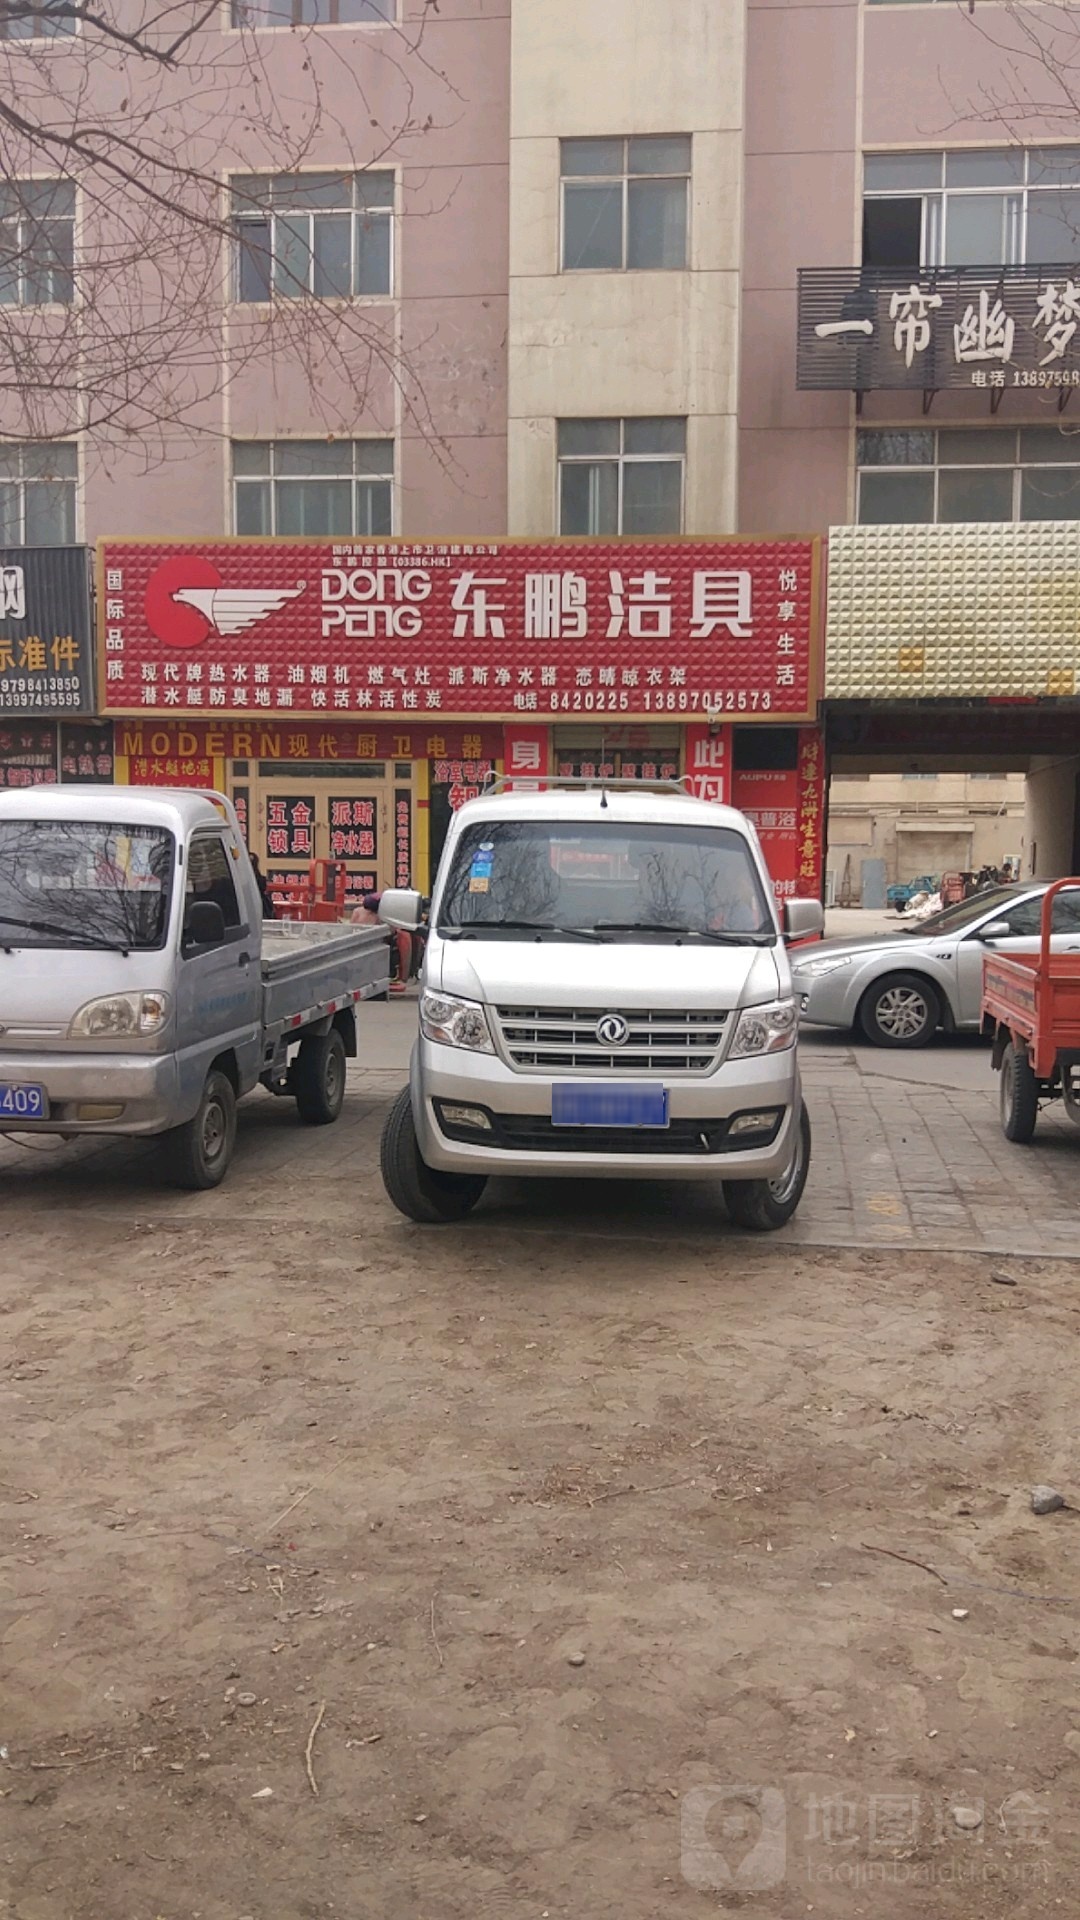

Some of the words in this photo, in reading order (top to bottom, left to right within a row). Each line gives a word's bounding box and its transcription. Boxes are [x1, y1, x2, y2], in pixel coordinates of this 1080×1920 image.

[971, 370, 1005, 387] 电话
[449, 570, 753, 638] 东鹏洁具
[106, 570, 126, 681] 国际品质
[776, 569, 798, 685] 悦享生活
[141, 664, 271, 683] 现代牌热水器
[287, 665, 351, 684] 油烟机
[367, 666, 431, 685] 燃气灶
[448, 667, 558, 686] 派斯净水器
[141, 686, 293, 707] 潜水艇防臭地漏
[310, 689, 442, 709] 快活林活性炭
[513, 692, 537, 710] 电话
[550, 692, 629, 709] 8420225
[123, 731, 281, 758] MODERN
[134, 759, 210, 778] 潜水艇地漏
[267, 802, 312, 827] 五金
[331, 802, 374, 826] 派斯
[268, 829, 311, 854] 锁具
[331, 831, 374, 856] 净水器
